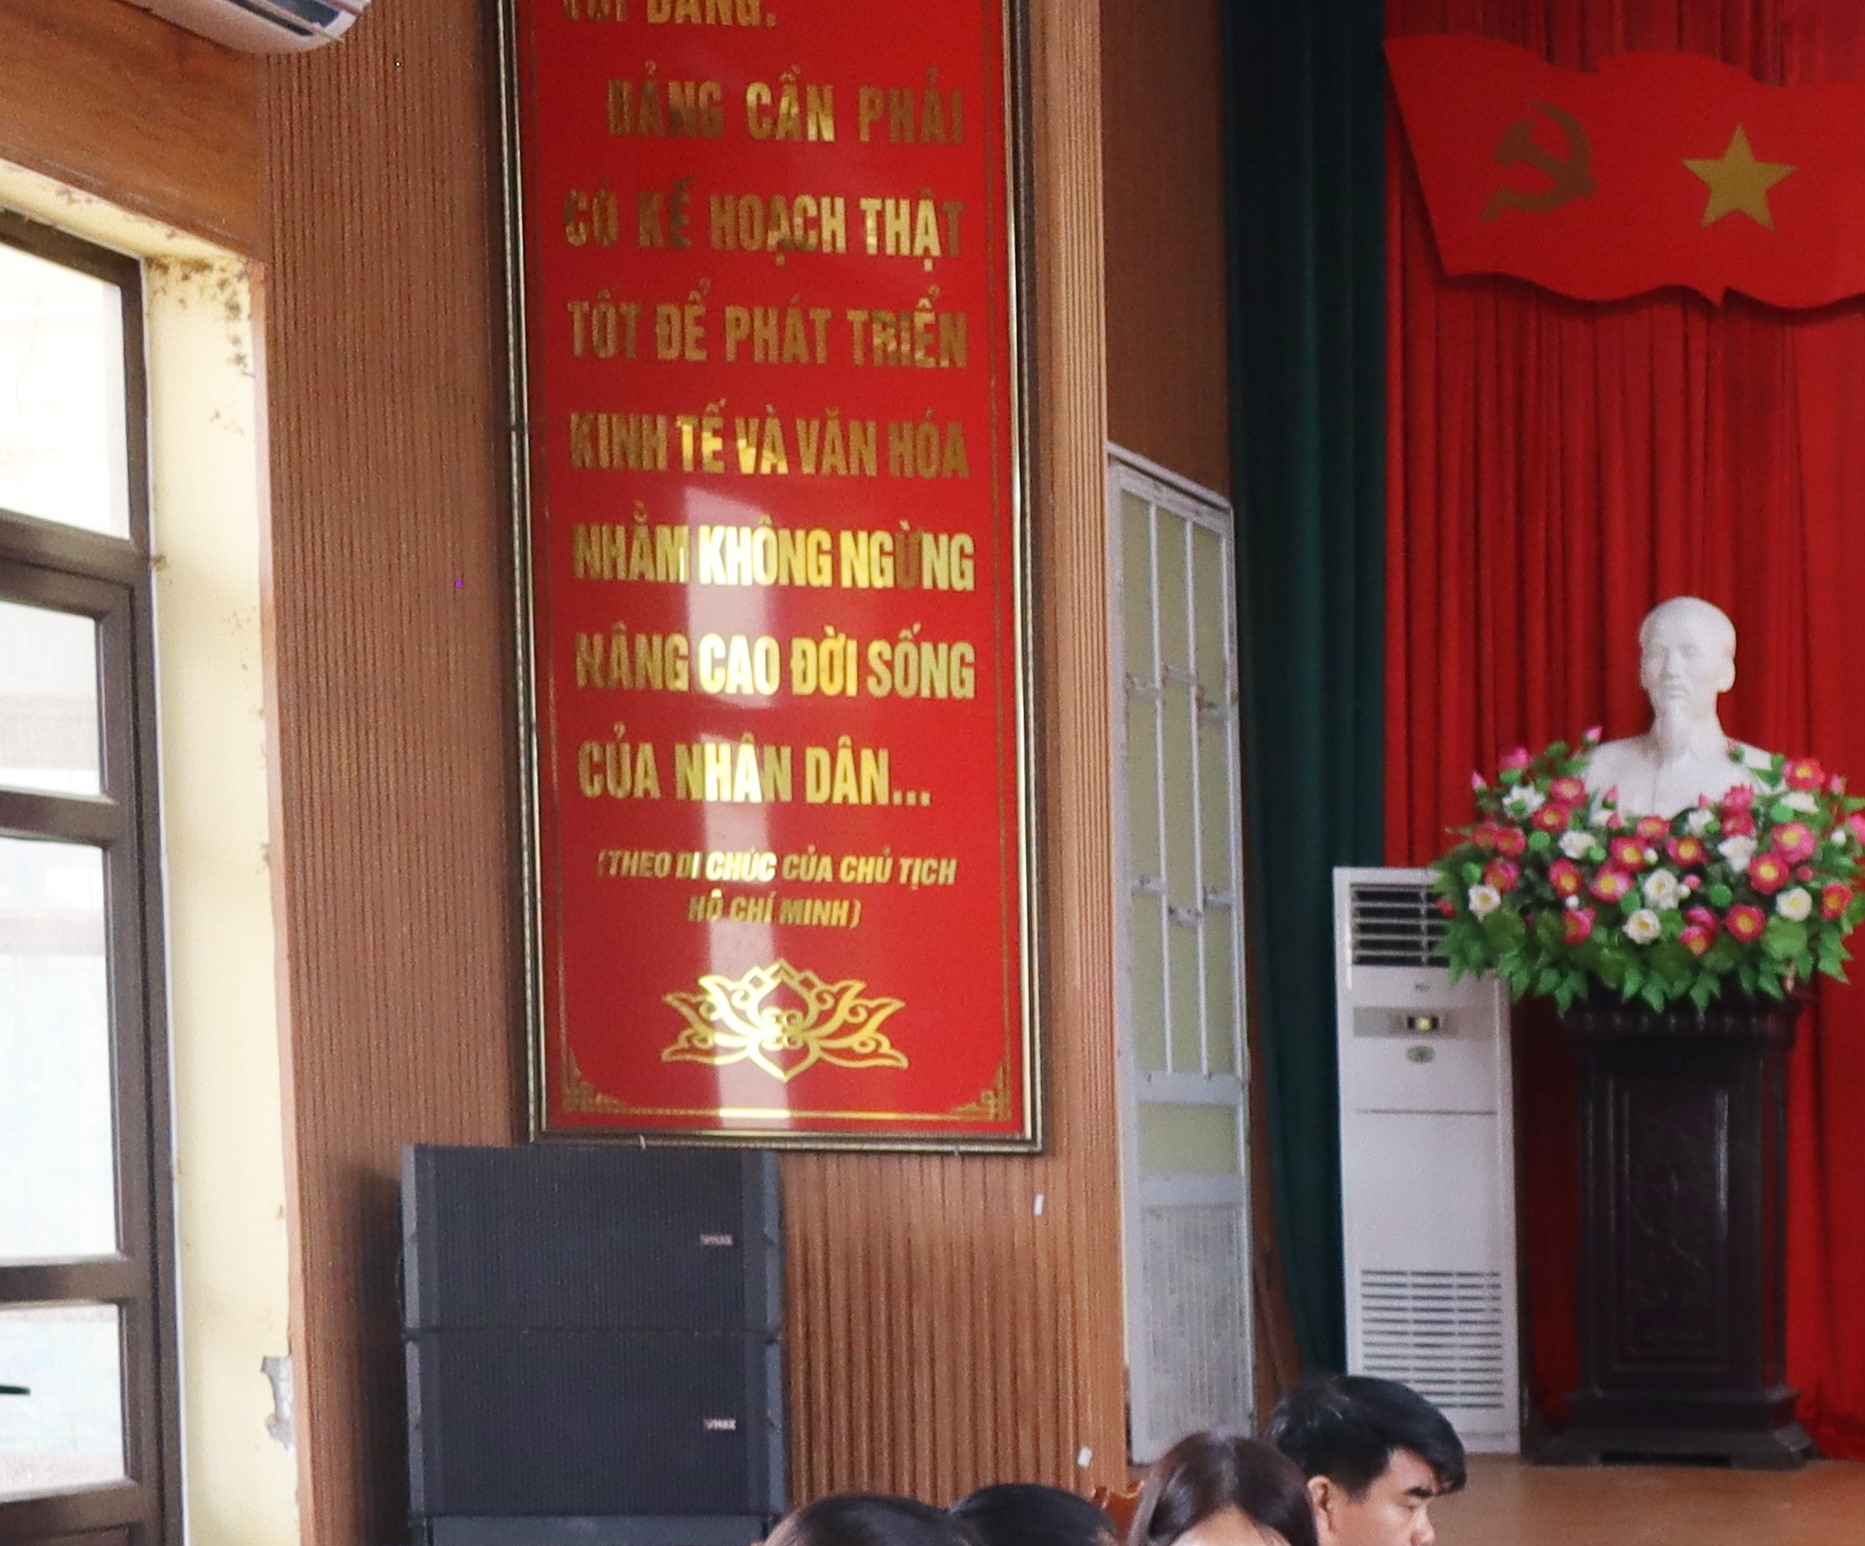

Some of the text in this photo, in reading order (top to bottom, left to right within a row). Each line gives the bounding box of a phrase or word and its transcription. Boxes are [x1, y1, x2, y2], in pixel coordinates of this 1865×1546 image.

[608, 61, 964, 144] ĐẢNG CẦN PHẢI
[563, 175, 964, 271] CÓ KẾ HOẠCH THẬT
[567, 277, 967, 368] TỐT ĐỂ PHÁT TRIỂN
[569, 399, 969, 479] KINH TẾ VÀ VĂN HÓA
[572, 501, 975, 592] NHẰM KHÔNG NGỪNG
[575, 621, 976, 700] NÂNG CAO ĐỜI SỐNG
[578, 723, 661, 800] CỦA
[675, 731, 792, 804] NHÂN
[599, 845, 957, 891] (THEO DI CHÚC CỦA CHỦ TỊCH
[729, 890, 776, 924] CHÍ
[779, 898, 862, 929] MINH)
